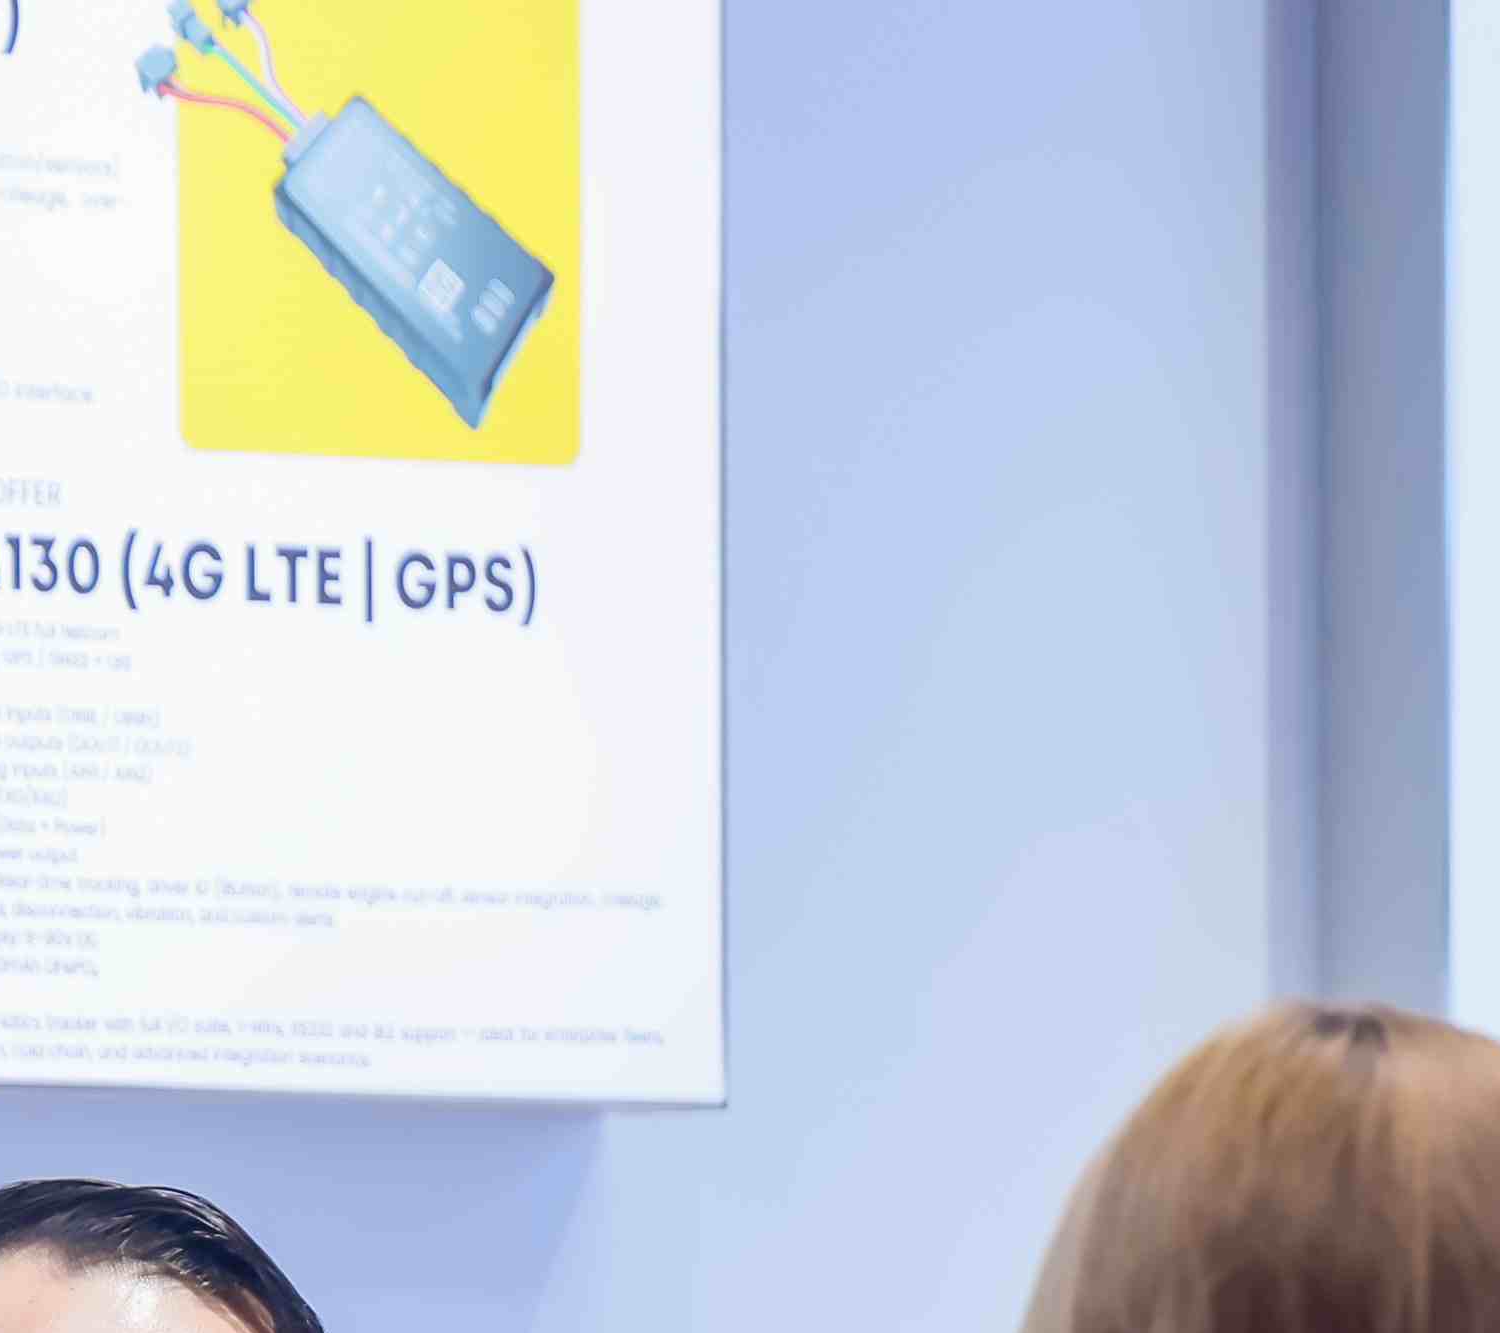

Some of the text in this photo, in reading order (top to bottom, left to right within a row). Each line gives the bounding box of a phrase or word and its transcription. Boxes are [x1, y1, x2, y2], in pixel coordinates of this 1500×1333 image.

[121, 529, 224, 611] (4G
[245, 542, 342, 606] LTE
[396, 546, 537, 626] GPS)
